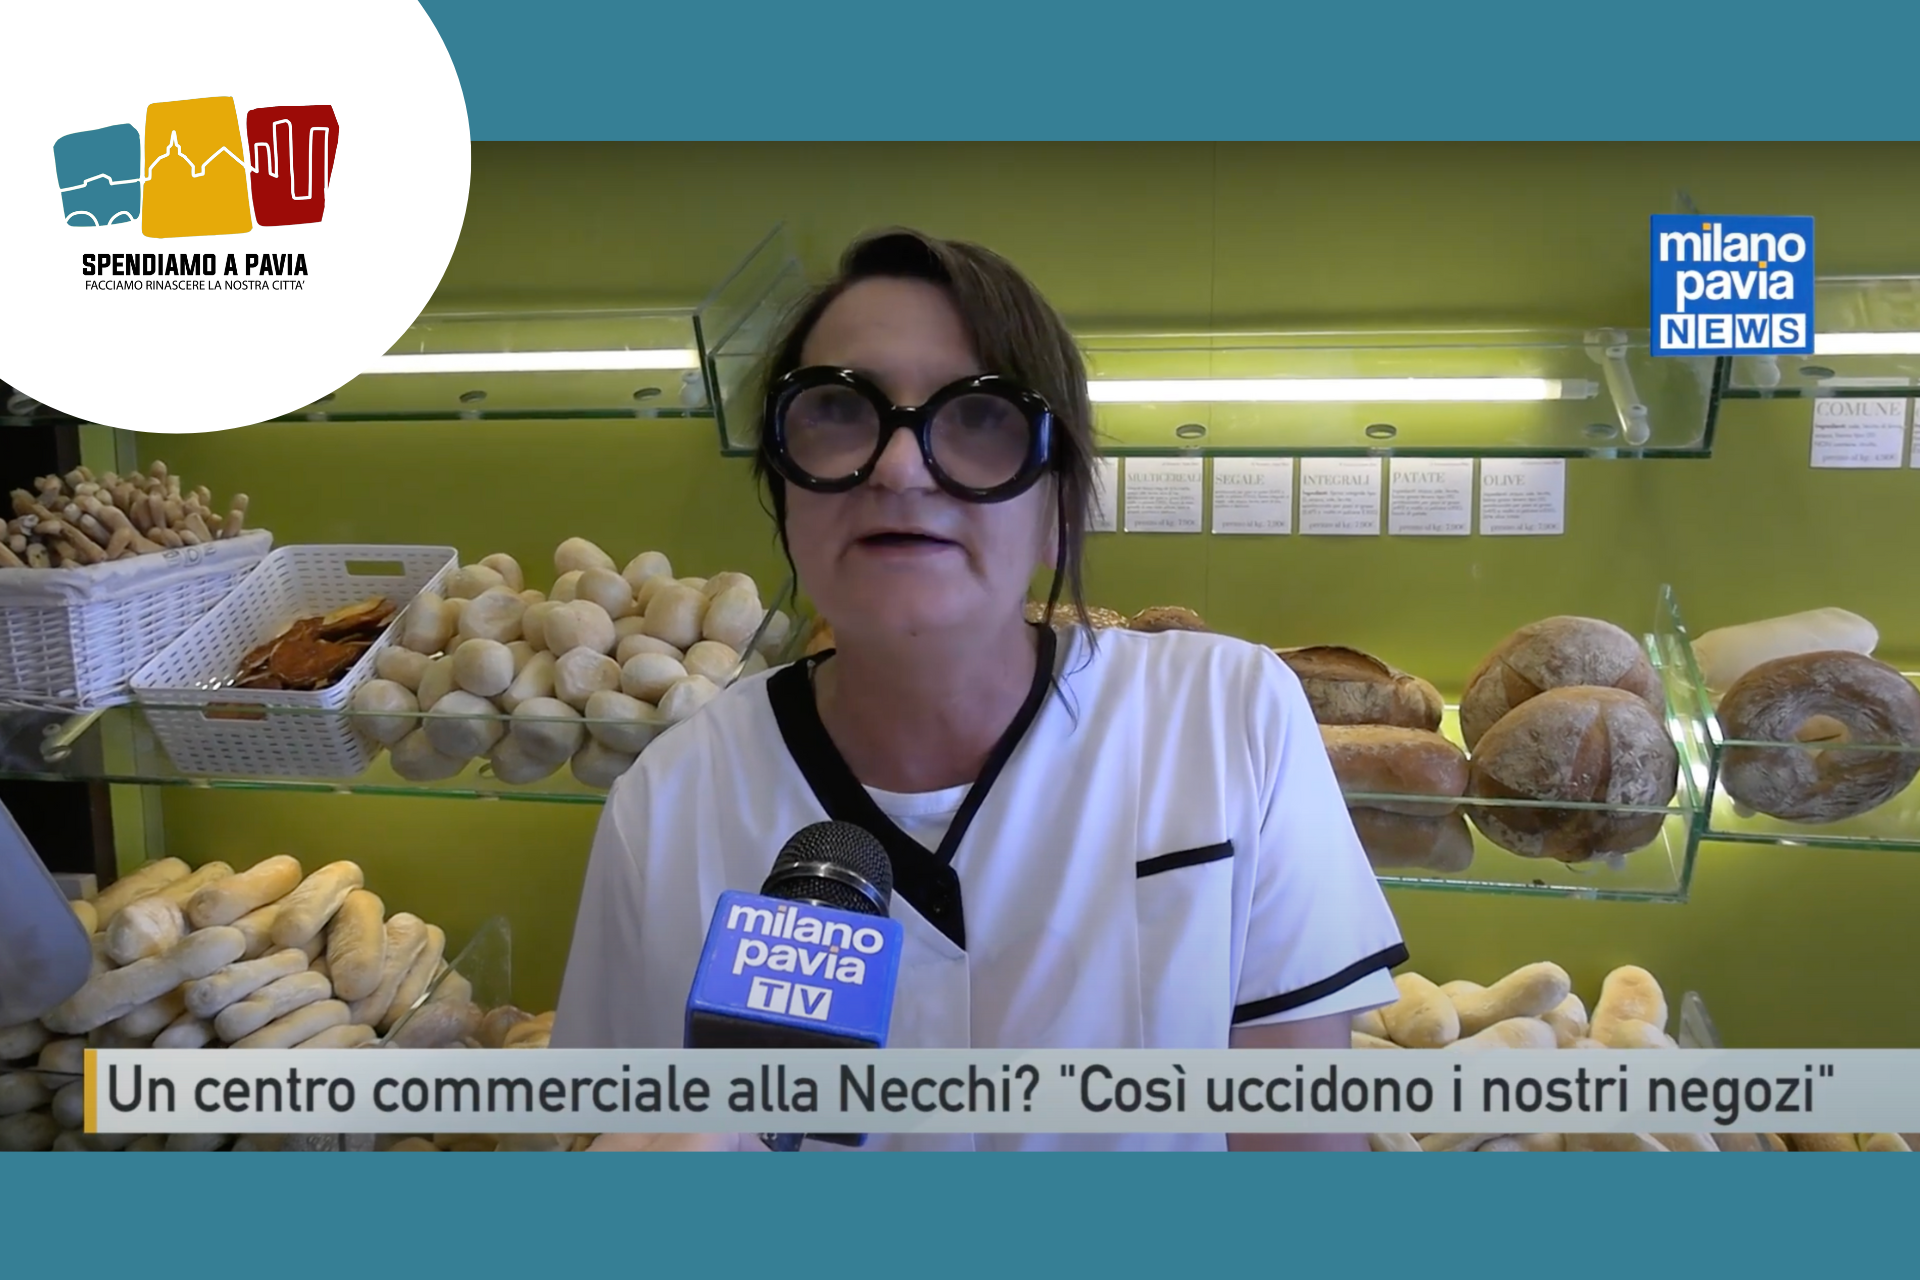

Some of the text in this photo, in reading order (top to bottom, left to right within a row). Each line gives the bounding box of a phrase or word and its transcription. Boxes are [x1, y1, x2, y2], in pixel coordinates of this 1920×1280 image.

[1816, 401, 1901, 416] COMUNE
[1127, 472, 1201, 482] MULTICEREALI
[1215, 474, 1265, 485] SEGALE
[1303, 474, 1370, 485] INTEGRALI
[1393, 471, 1446, 483] PATATE
[1483, 474, 1525, 486] OLIVE
[727, 905, 884, 954] milano
[732, 938, 866, 985] pavia
[758, 980, 828, 1016] TV
